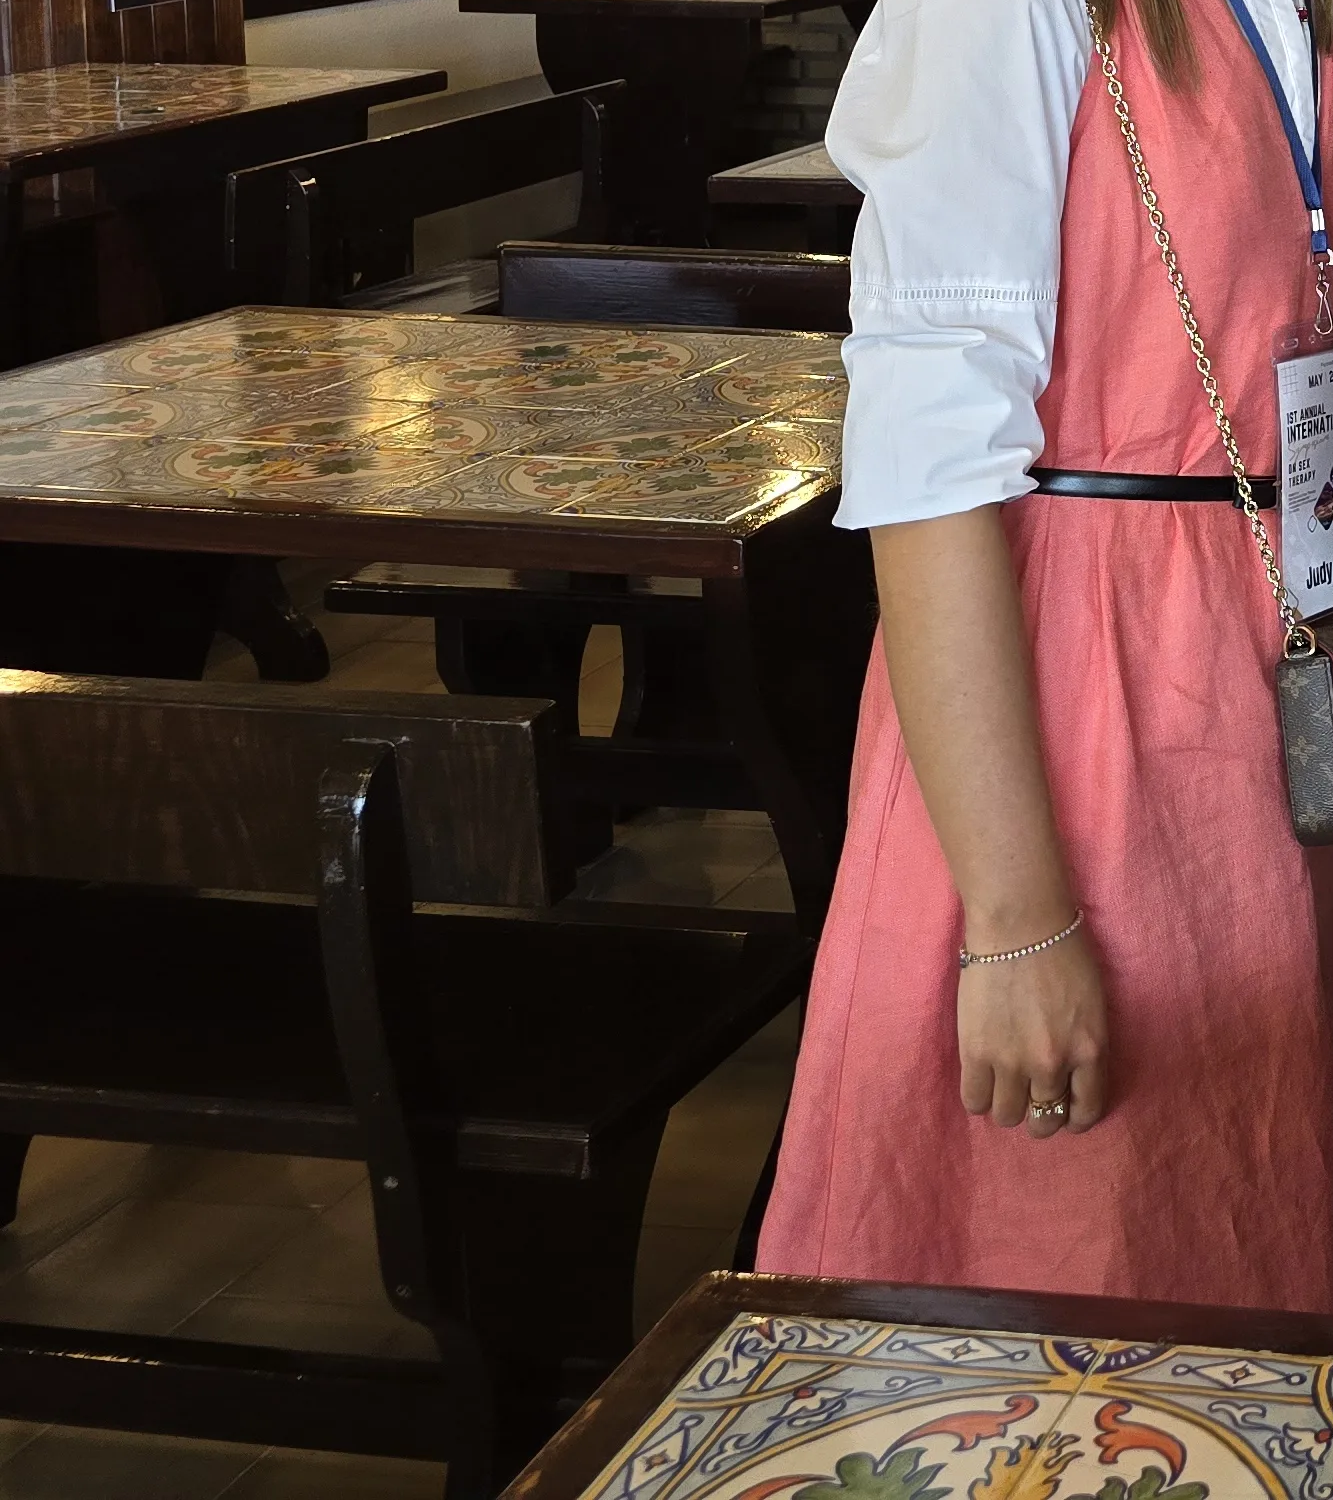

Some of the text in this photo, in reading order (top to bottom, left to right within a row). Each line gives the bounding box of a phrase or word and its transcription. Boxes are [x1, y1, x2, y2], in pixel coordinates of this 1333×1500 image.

[1308, 373, 1323, 388] MAY
[1287, 403, 1326, 425] 1ST ANNUAL
[1289, 458, 1311, 474] ON SEX
[1289, 470, 1316, 489] THERAPY
[1306, 561, 1332, 589] Judy
